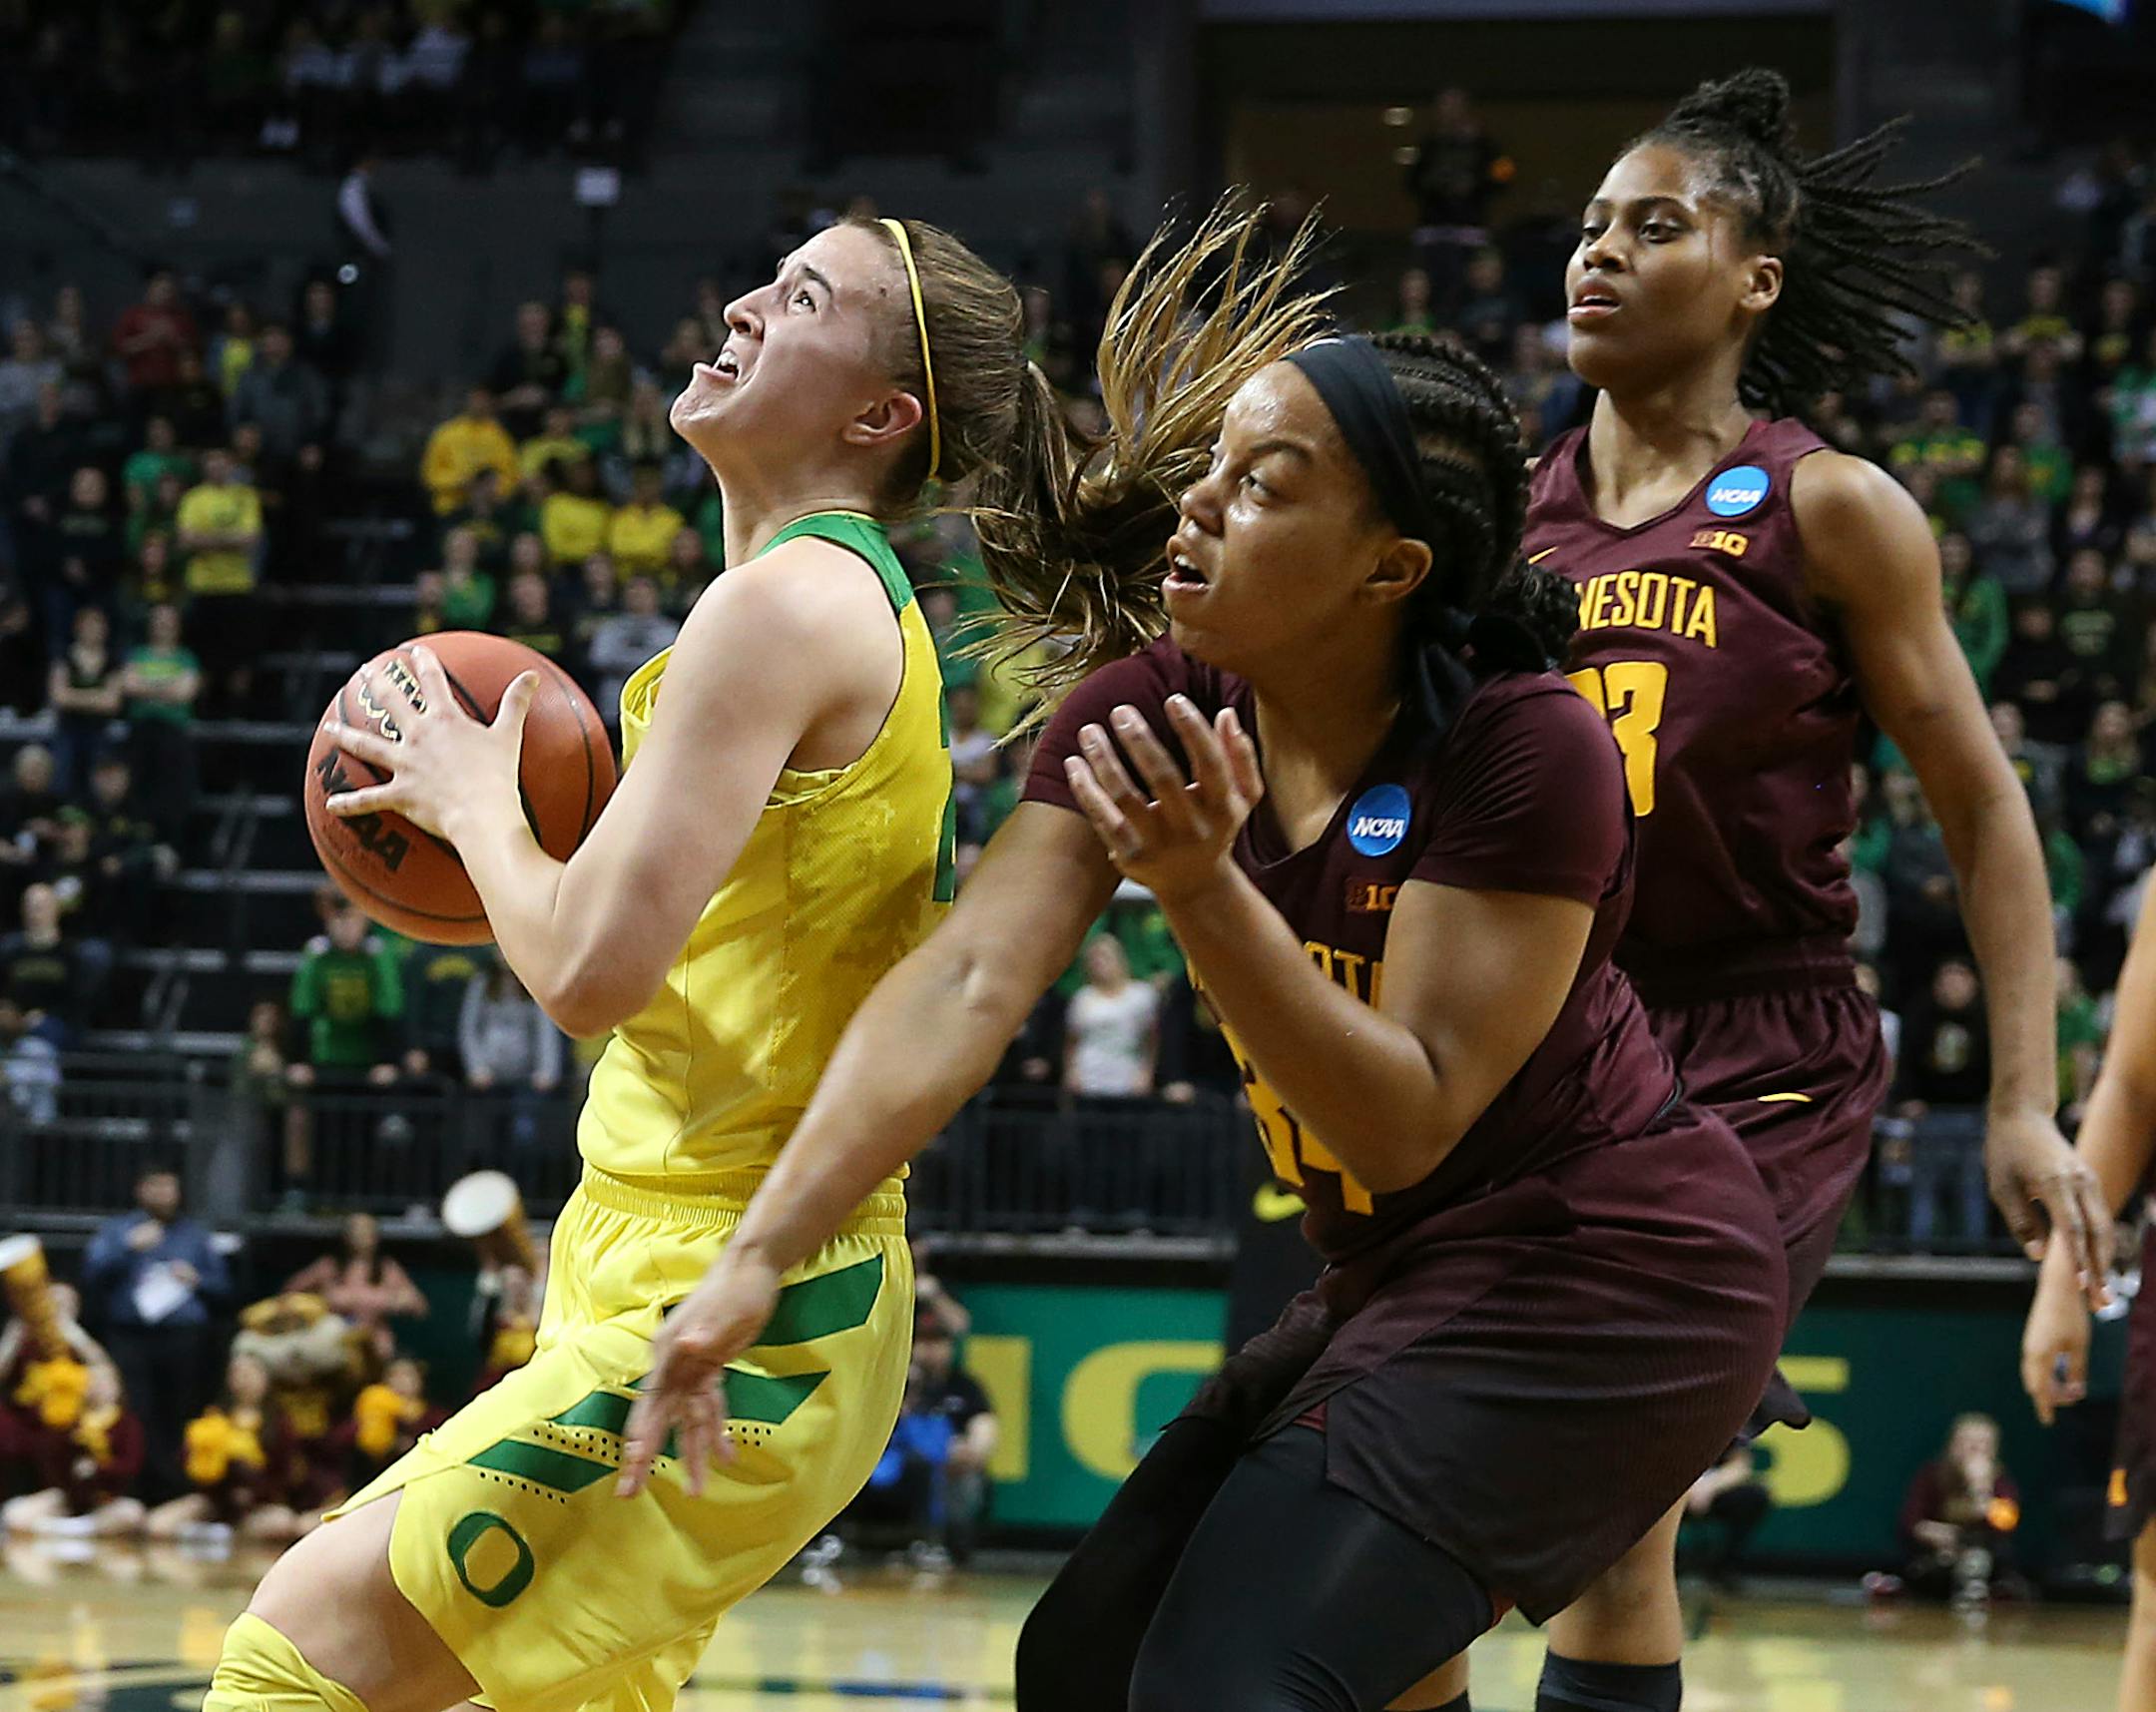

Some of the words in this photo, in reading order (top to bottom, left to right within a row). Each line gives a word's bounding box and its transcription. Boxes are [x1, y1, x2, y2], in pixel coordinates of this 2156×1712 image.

[1710, 488, 1762, 503] NCAA
[1564, 661, 1668, 817] 3
[314, 751, 410, 872] NAA
[1352, 817, 1405, 839] NCAA
